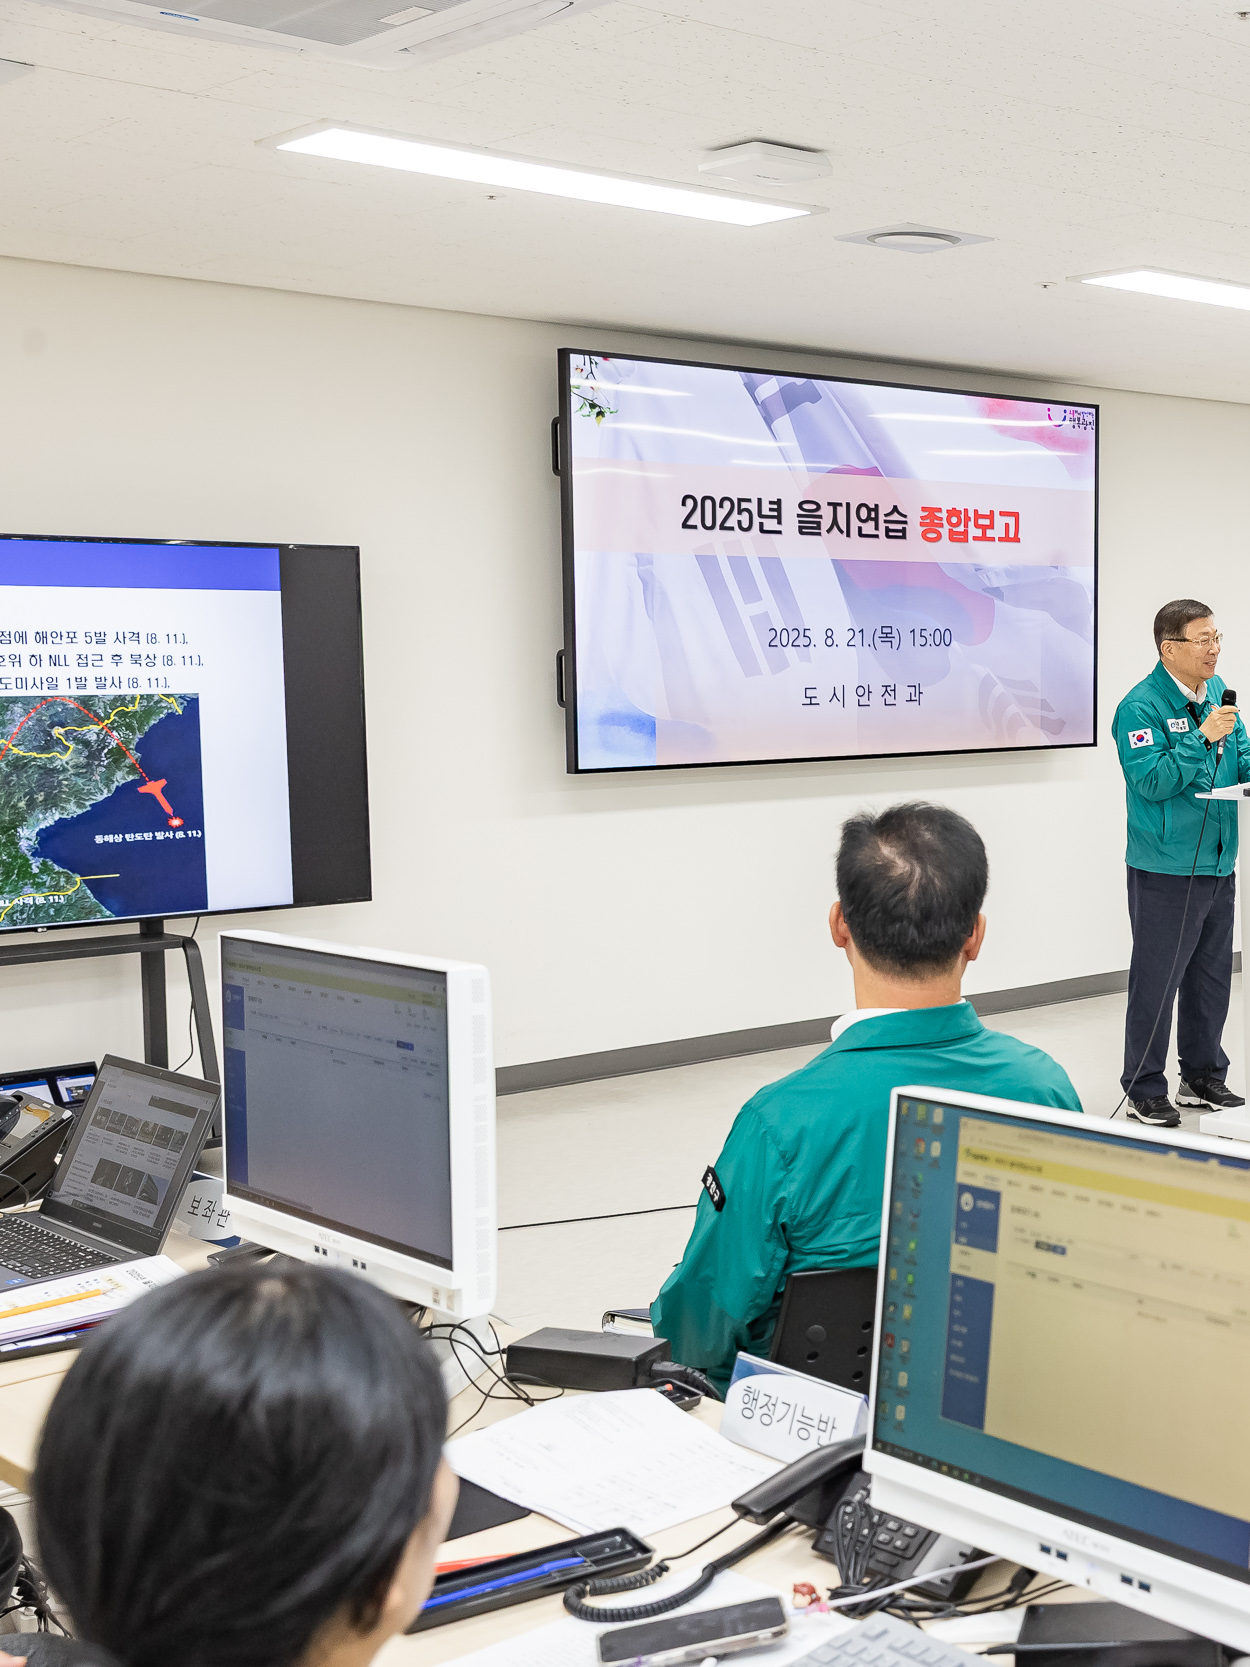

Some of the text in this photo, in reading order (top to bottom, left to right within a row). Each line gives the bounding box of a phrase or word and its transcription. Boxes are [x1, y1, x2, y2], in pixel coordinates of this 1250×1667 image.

[681, 494, 1021, 543] 2025년 을지연습 종합보고
[0, 630, 28, 645] 점에
[34, 630, 78, 645] 해안포
[84, 631, 107, 645] 5발
[113, 631, 141, 645] 사격
[768, 625, 952, 651] 2025. 8. 21.(목) 15:00
[29, 654, 43, 667] 하
[48, 654, 70, 667] NLL
[76, 653, 104, 667] 접근
[111, 653, 123, 667] 후
[130, 653, 157, 667] 북상
[0, 676, 59, 691] 도미사일
[66, 676, 88, 690] 1발
[94, 676, 122, 690] 발사
[187, 1195, 231, 1228] 보좌관
[741, 1385, 838, 1447] 행정기능반
